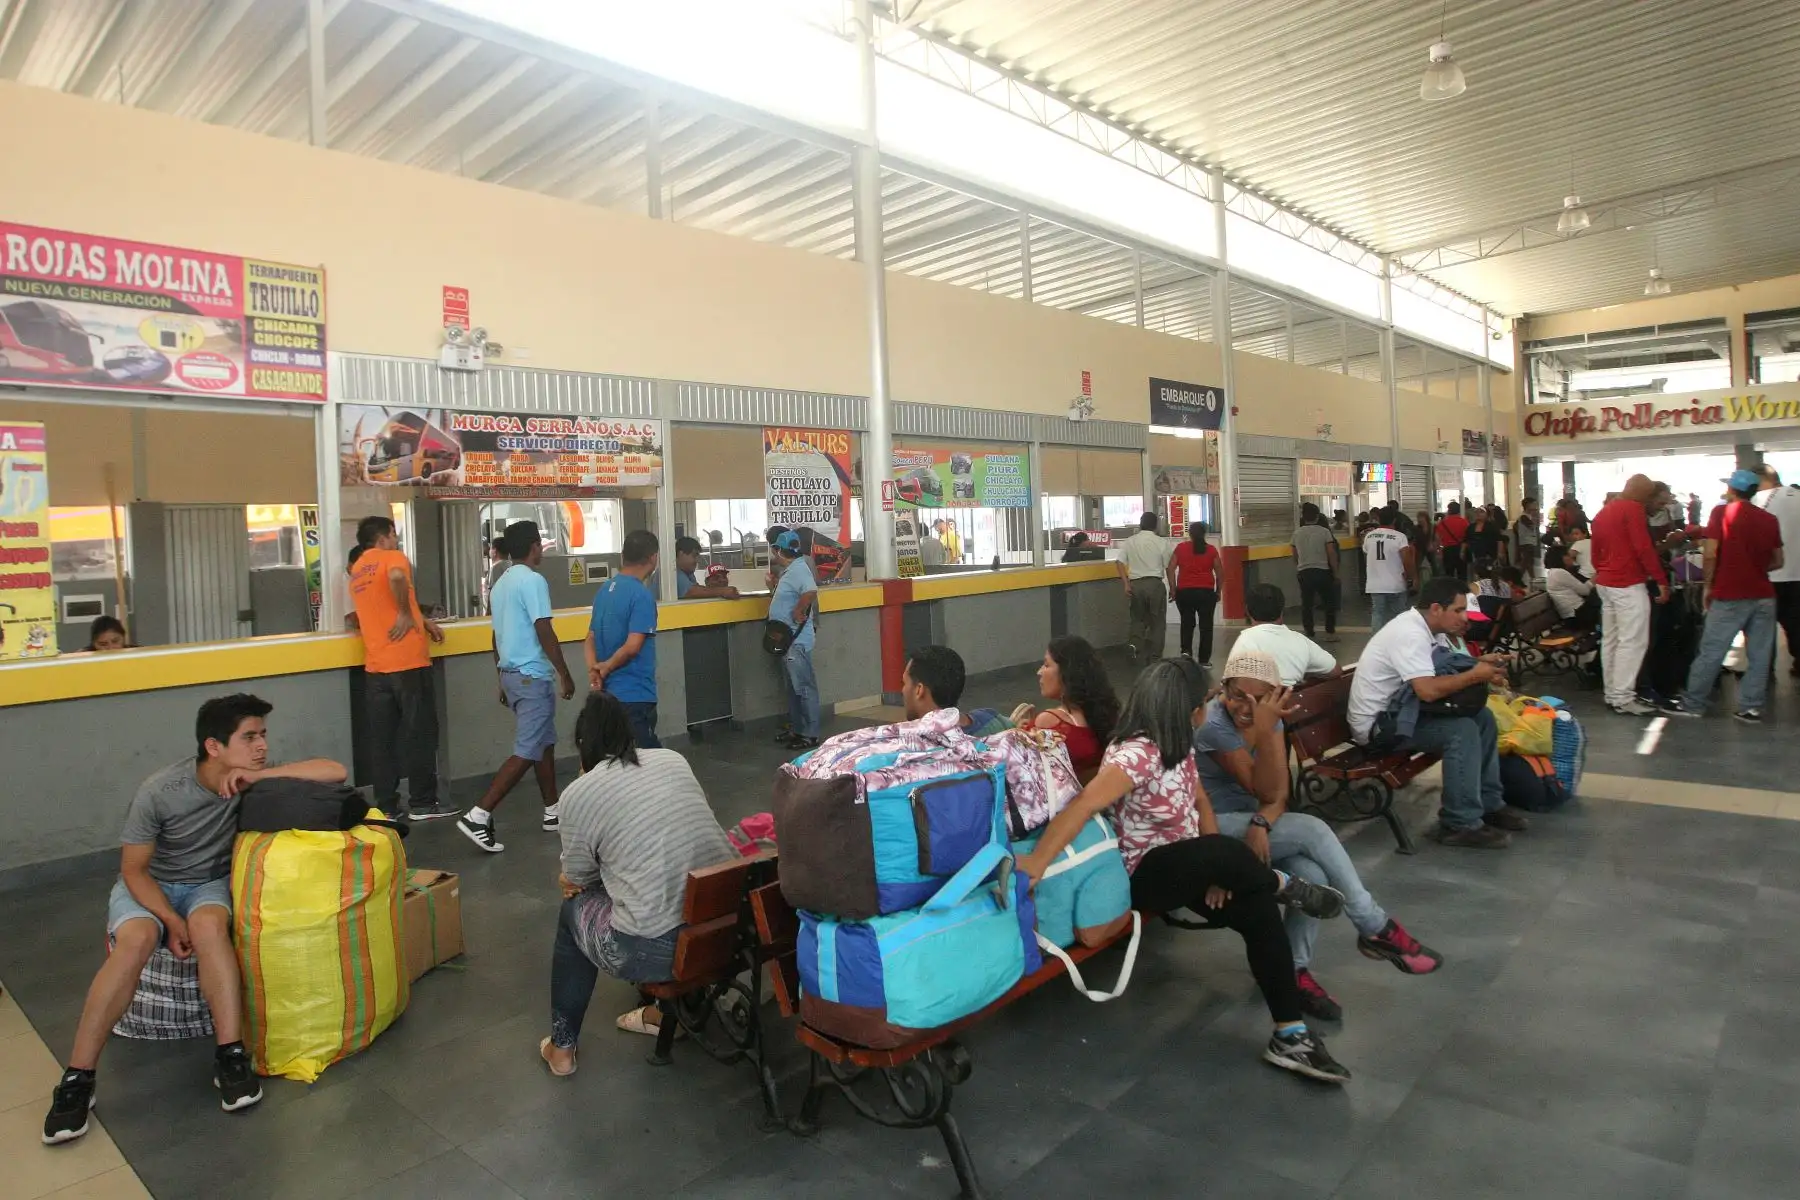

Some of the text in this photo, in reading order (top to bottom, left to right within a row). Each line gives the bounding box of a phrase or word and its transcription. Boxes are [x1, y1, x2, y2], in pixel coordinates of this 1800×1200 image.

[5, 233, 233, 298] ROJAS MOLINA
[5, 279, 64, 298] NUEVA
[253, 332, 319, 350] CHOCOPE
[1160, 387, 1206, 406] EMBARQUE
[452, 414, 656, 437] MURGA SERRANO S.A.C.
[1524, 408, 1598, 439] Chifa
[1599, 398, 1725, 432] Polleria
[498, 437, 620, 451] SERVICIO DIRECTO
[766, 429, 849, 455] VALTURS
[985, 454, 1020, 464] SULLANA
[769, 467, 807, 475] DESTINOS
[987, 465, 1019, 474] PIURA
[465, 475, 505, 485] LAMBAYEQUE
[770, 478, 831, 490] CHICLAYO
[985, 476, 1023, 485] CHICLAYO
[771, 494, 838, 507] CHIMBOTE
[771, 510, 832, 524] TRUJILLO
